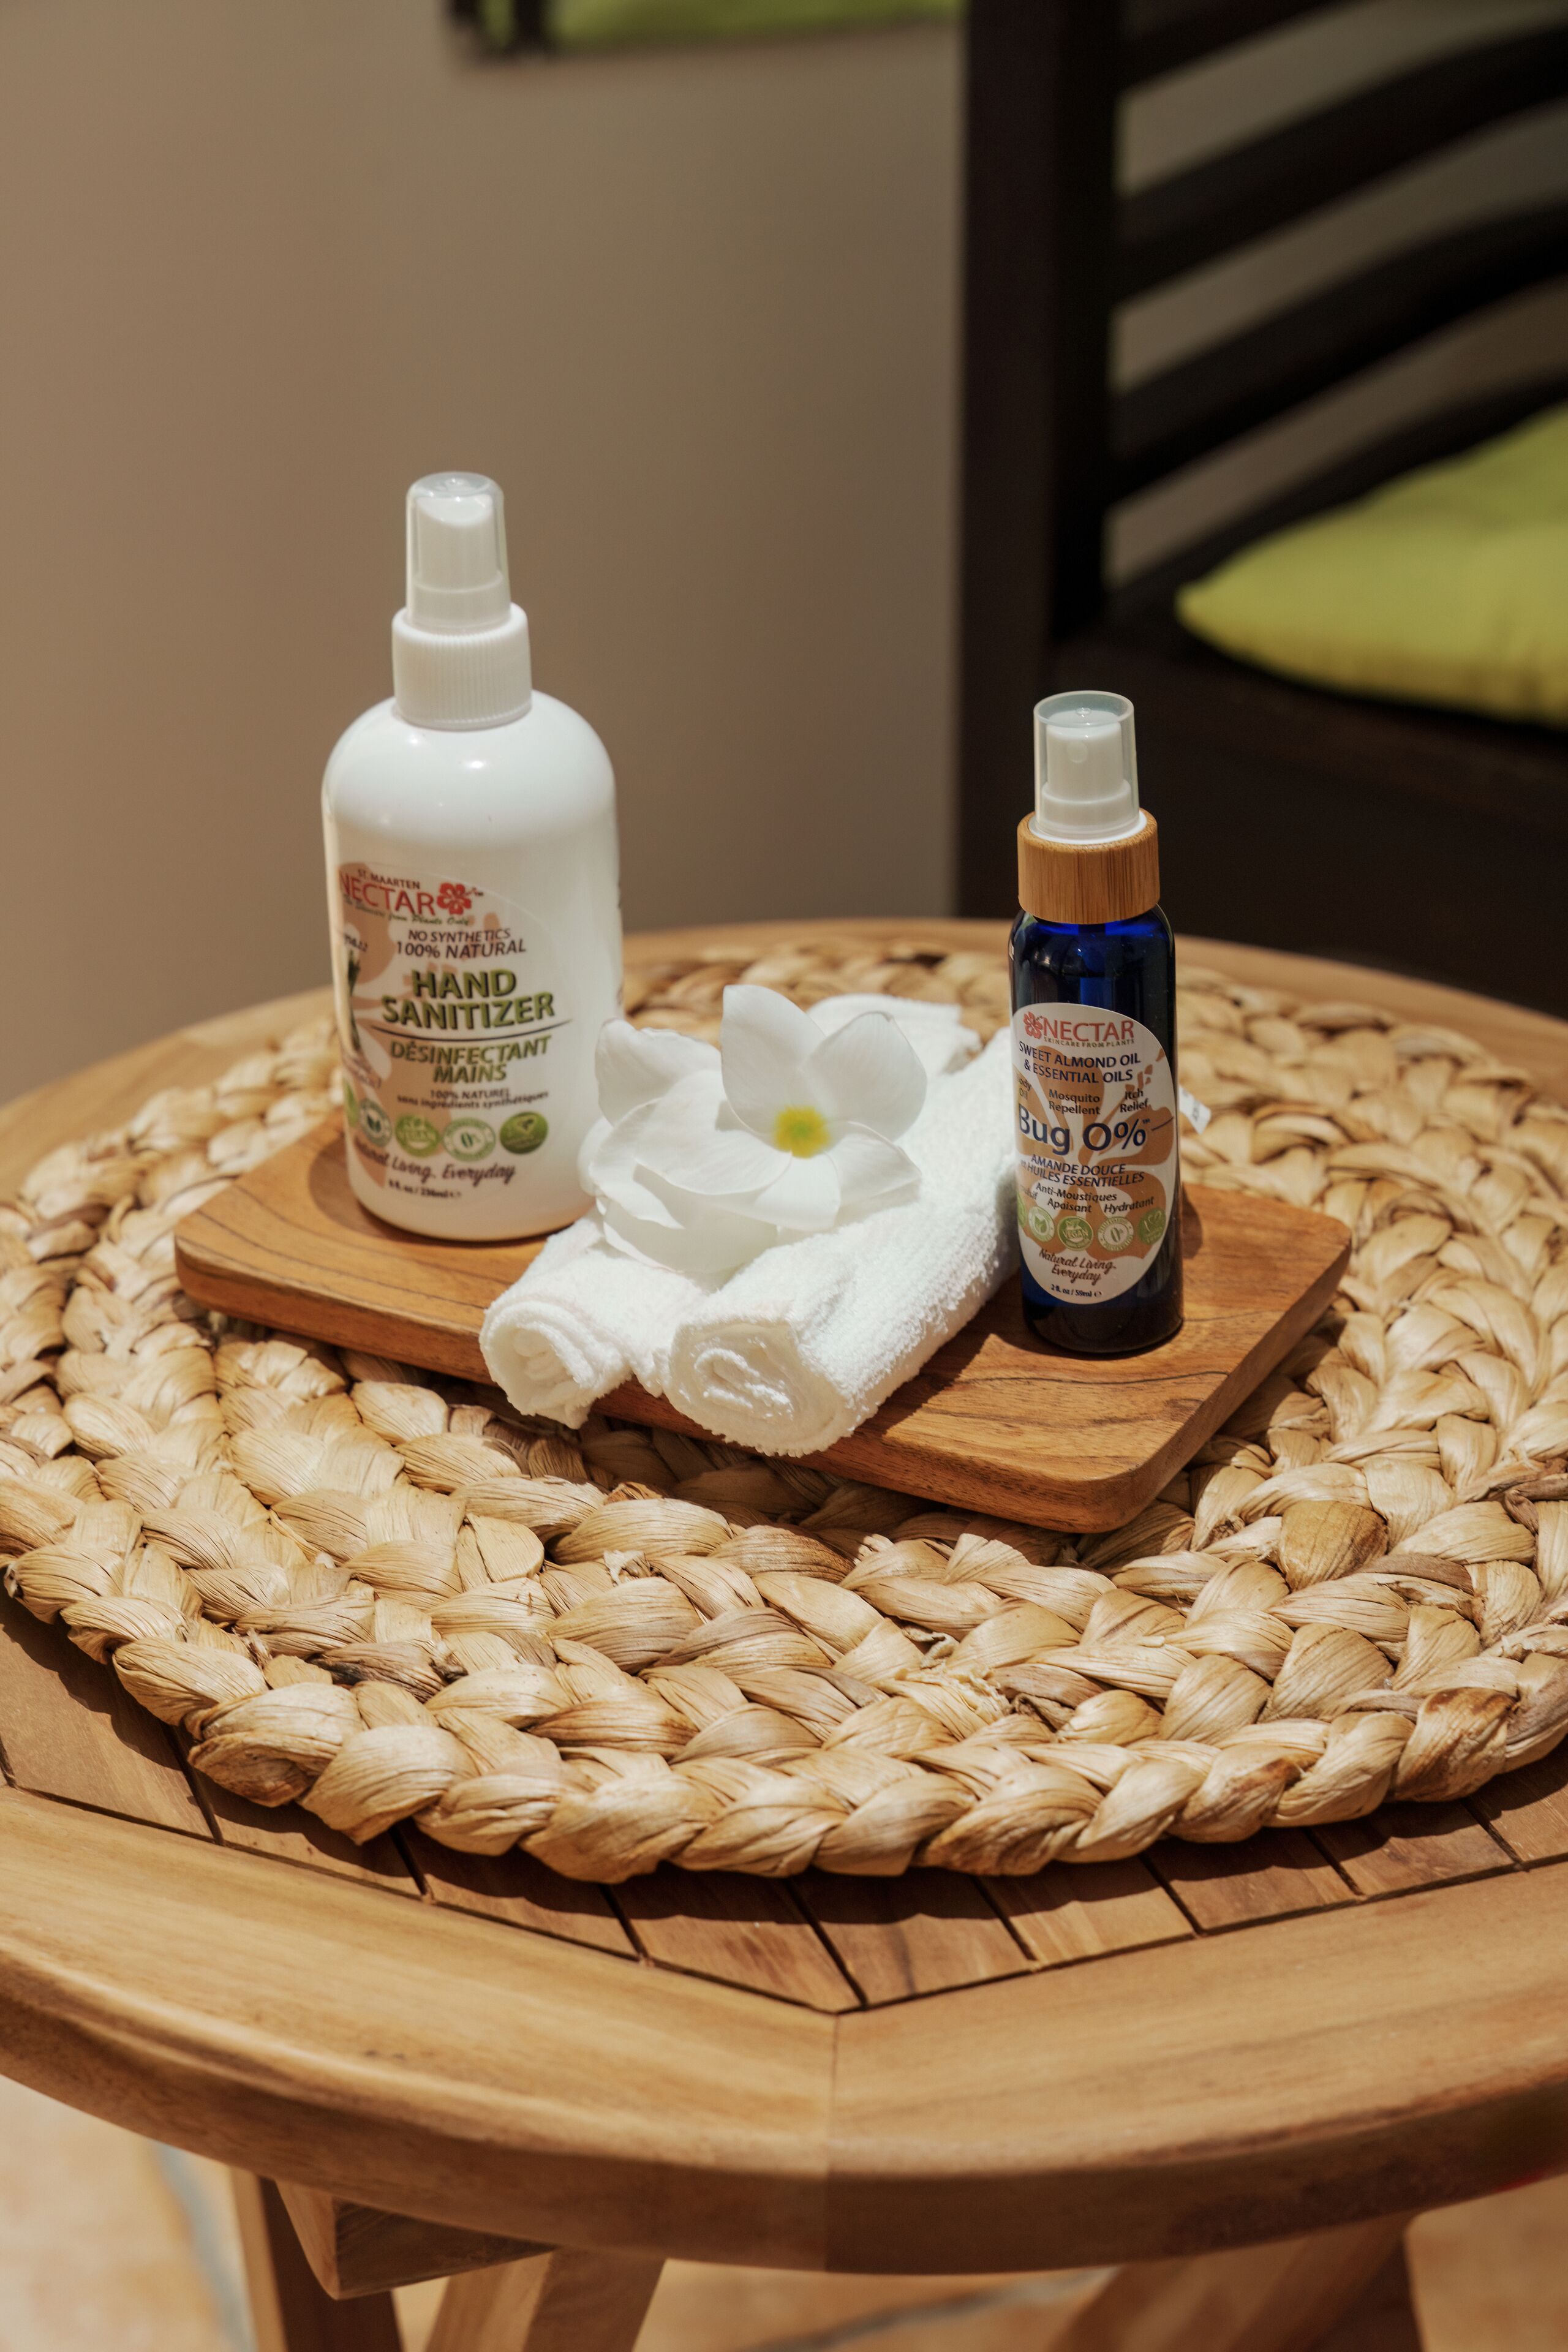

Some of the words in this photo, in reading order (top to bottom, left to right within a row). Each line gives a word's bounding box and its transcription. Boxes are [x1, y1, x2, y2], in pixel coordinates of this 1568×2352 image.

[370, 872, 421, 889] MAARTEN
[339, 871, 435, 916] NECTAR
[409, 929, 428, 942] NO
[431, 928, 511, 944] SYNTHETICS
[396, 941, 440, 958] 100%
[445, 939, 527, 959] NATURAL
[411, 969, 518, 999] HAND
[381, 992, 556, 1030] SANITIZER
[1043, 1016, 1134, 1042] NECTAR
[1043, 1036, 1080, 1048] SKINCARE
[1106, 1038, 1135, 1048] PLANTS
[1019, 1041, 1052, 1063] SWEET
[1054, 1054, 1117, 1069] ALMOND
[1120, 1052, 1141, 1066] OIL
[432, 1063, 507, 1084] MAINS
[1023, 1058, 1031, 1071] &
[1033, 1063, 1099, 1084] ESSENTIAL
[1103, 1069, 1133, 1082] OILS
[1049, 1088, 1101, 1104] Mosquito
[1125, 1088, 1144, 1100] Itch
[1049, 1101, 1101, 1115] Repellent
[1120, 1099, 1149, 1114] Relief
[1019, 1102, 1071, 1156] Bug
[442, 1161, 516, 1187] Everyday
[1028, 1163, 1060, 1183] HUILES
[1063, 1171, 1145, 1187] ESSENTIELLES
[1031, 1154, 1080, 1175] AMANDE
[1080, 1163, 1126, 1175] DOUCE
[1036, 1182, 1118, 1203] Anti-Moustiques
[1047, 1197, 1092, 1213] Apaisant
[1104, 1196, 1155, 1214] Hydratant
[1062, 1227, 1089, 1239] VEGAN
[1039, 1248, 1078, 1267] Natural
[1051, 1264, 1102, 1286] Everyday
